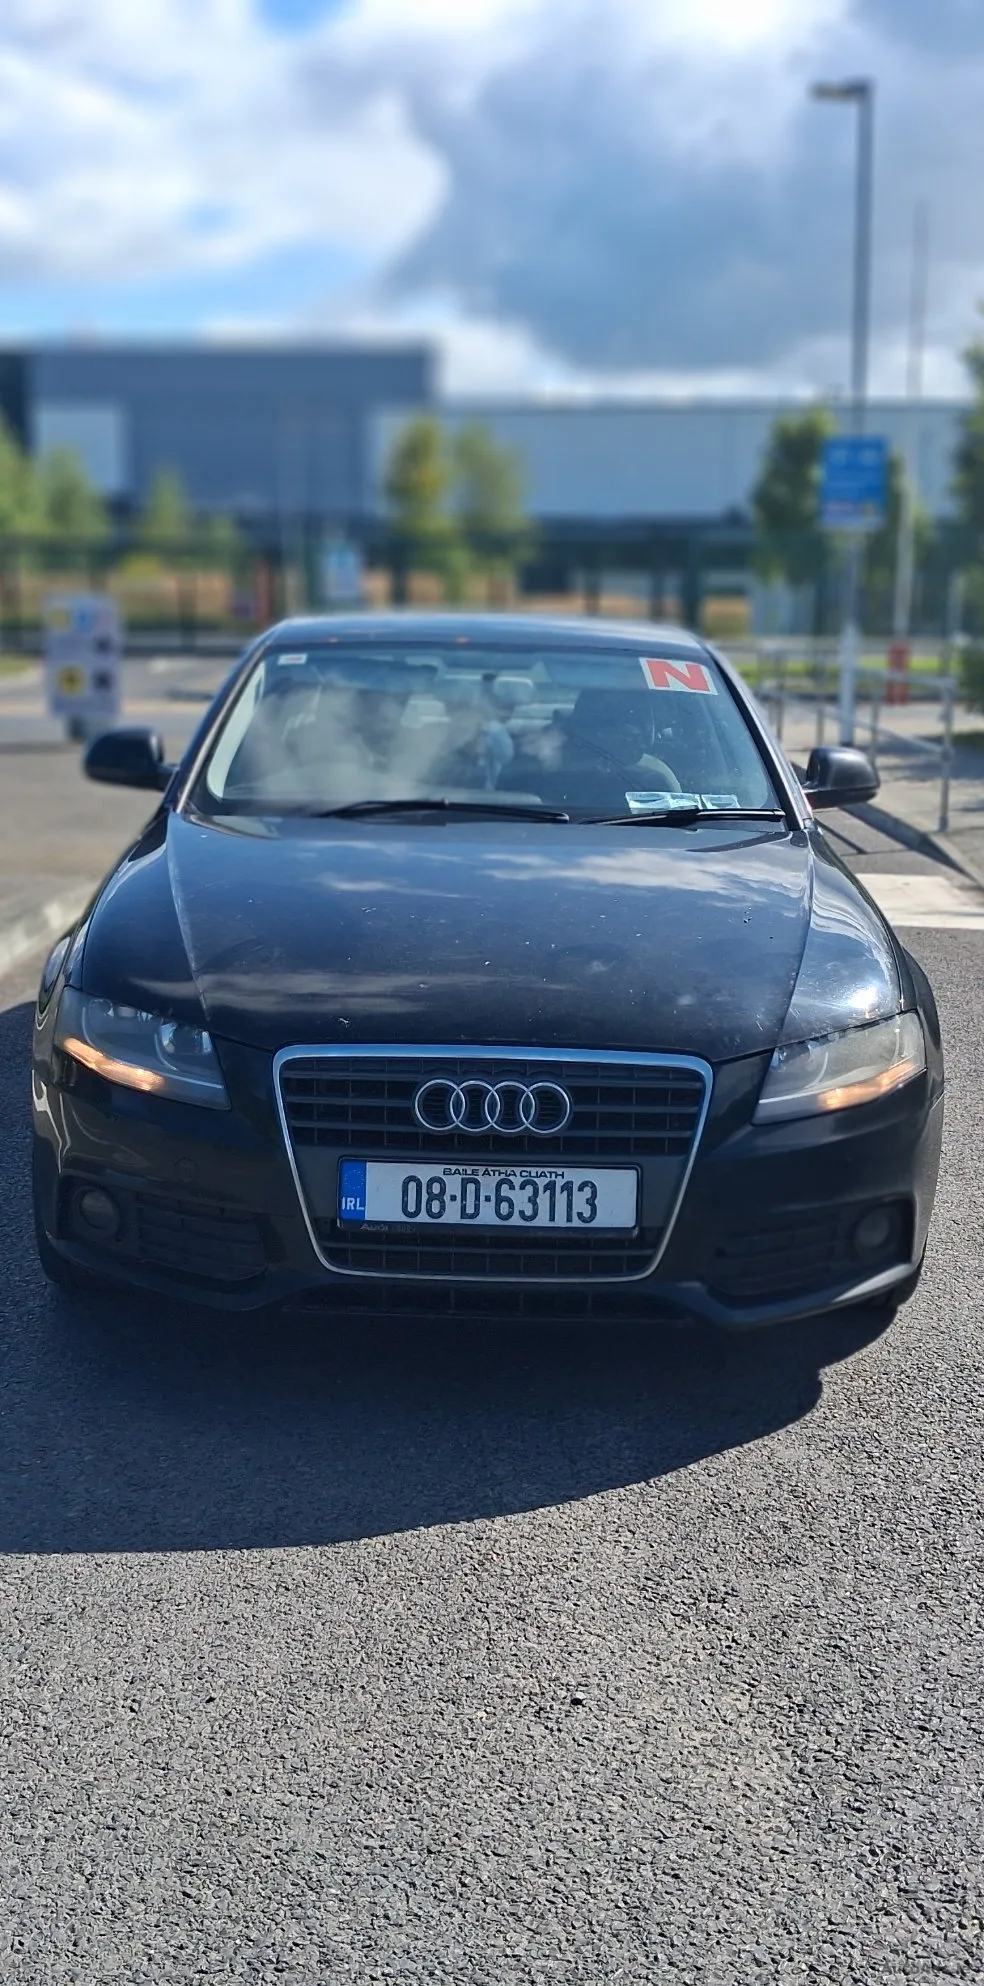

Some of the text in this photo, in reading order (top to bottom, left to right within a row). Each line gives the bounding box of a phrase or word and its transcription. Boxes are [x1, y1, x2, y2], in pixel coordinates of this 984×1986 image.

[646, 659, 711, 692] N
[442, 1167, 480, 1177] BAILE
[519, 1169, 565, 1180] CLIATH
[341, 1197, 365, 1210] IRL
[401, 1174, 598, 1225] 08-D-63113
